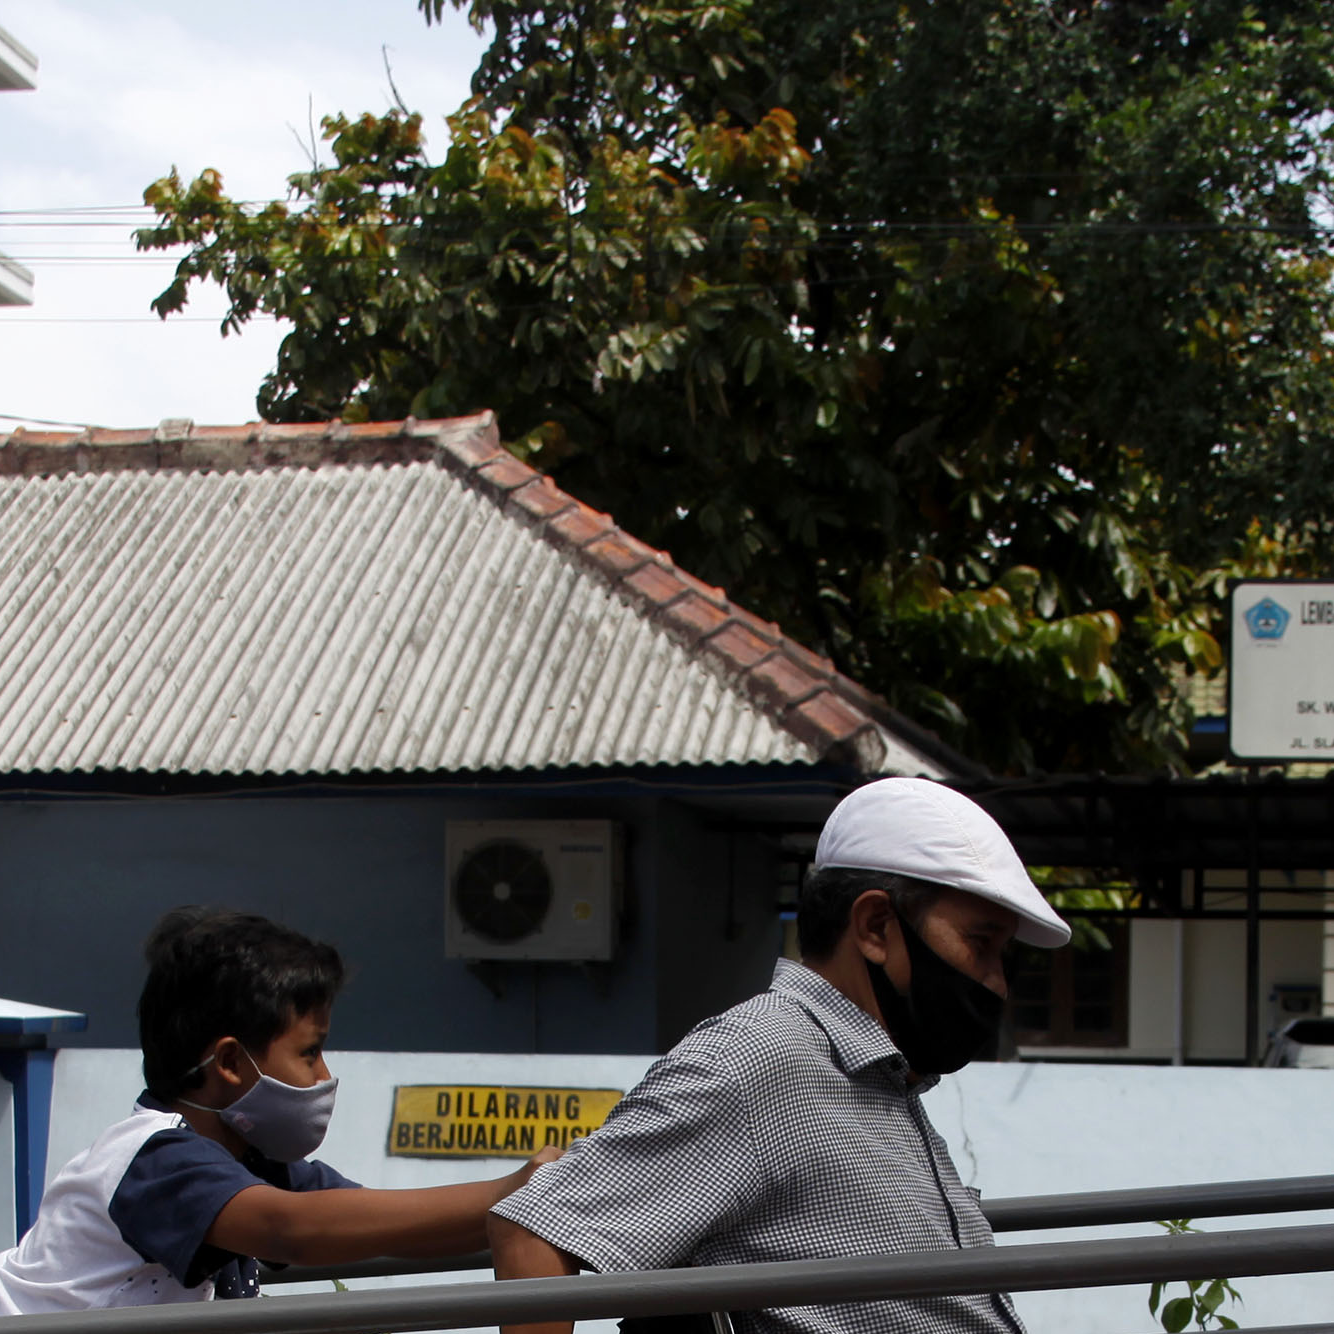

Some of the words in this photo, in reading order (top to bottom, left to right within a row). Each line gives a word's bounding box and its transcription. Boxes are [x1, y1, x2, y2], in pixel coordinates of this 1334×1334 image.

[436, 1092, 581, 1120] DILARANG
[396, 1123, 535, 1150] BERJUALAN
[545, 1126, 601, 1151] DIS
